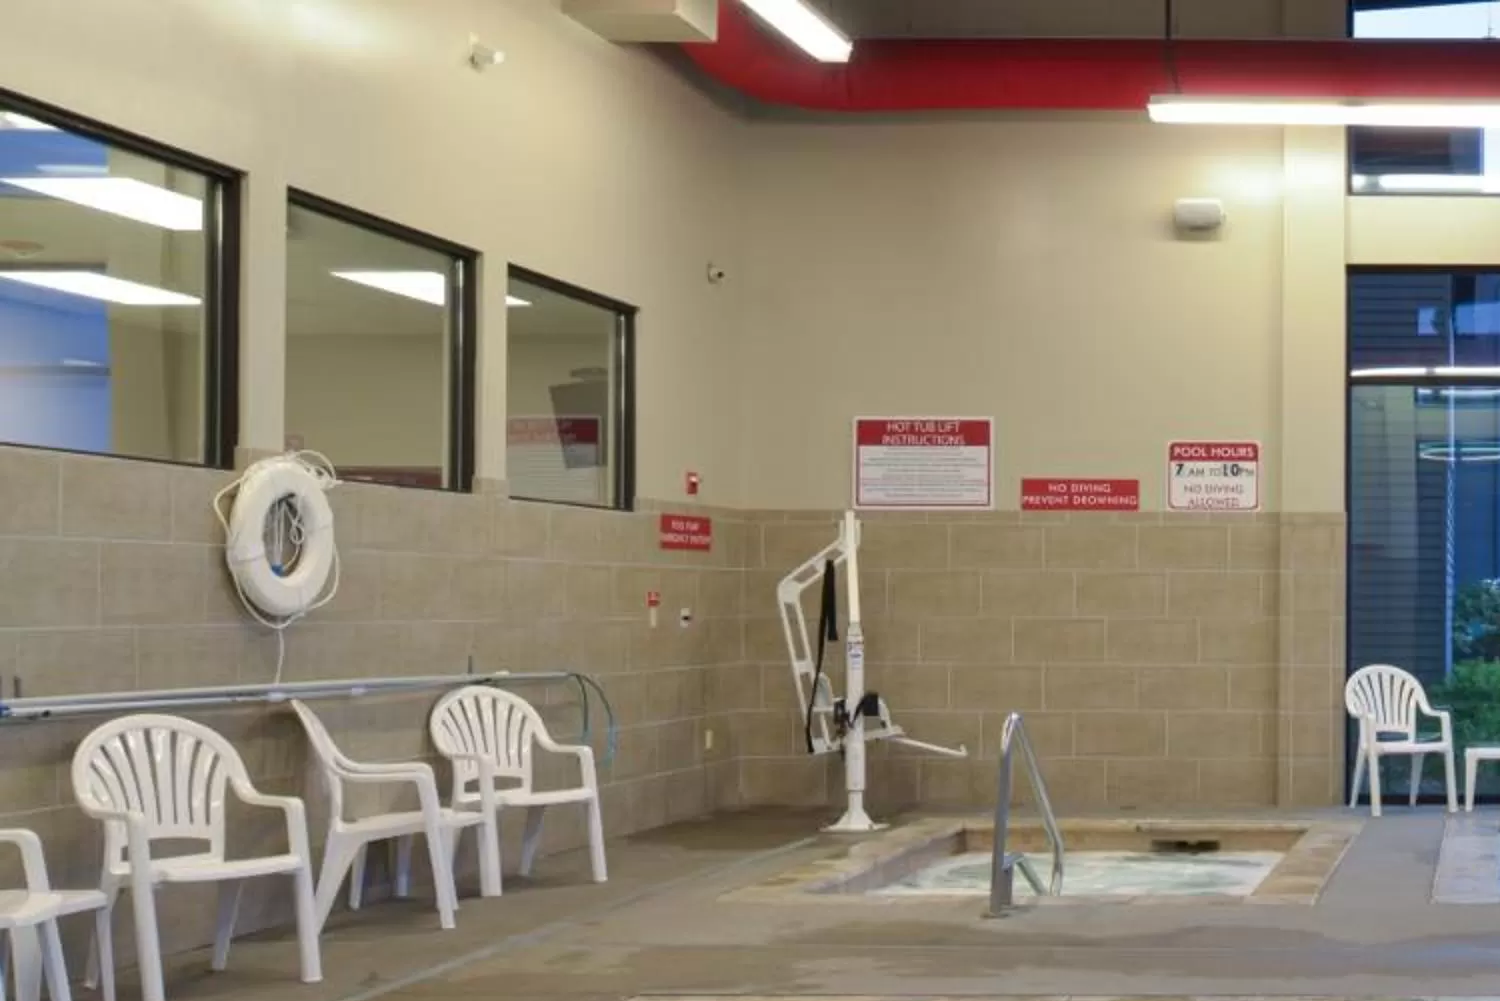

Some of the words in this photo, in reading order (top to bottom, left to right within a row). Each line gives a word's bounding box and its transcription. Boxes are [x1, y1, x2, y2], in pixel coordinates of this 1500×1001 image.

[886, 421, 910, 433] HOT
[913, 421, 936, 433] TUB
[938, 421, 961, 433] LIFT
[881, 434, 965, 446] INSTRUCTIONS
[1174, 446, 1208, 457] POOL
[1211, 446, 1254, 457] HOURS
[1175, 463, 1185, 476] 7
[1047, 483, 1068, 493] NO
[1071, 483, 1111, 493] DIVING
[1183, 483, 1202, 493] NO
[1204, 483, 1244, 494] DIVING
[1022, 495, 1069, 505] PREVENT
[1073, 495, 1137, 505] DROWNING
